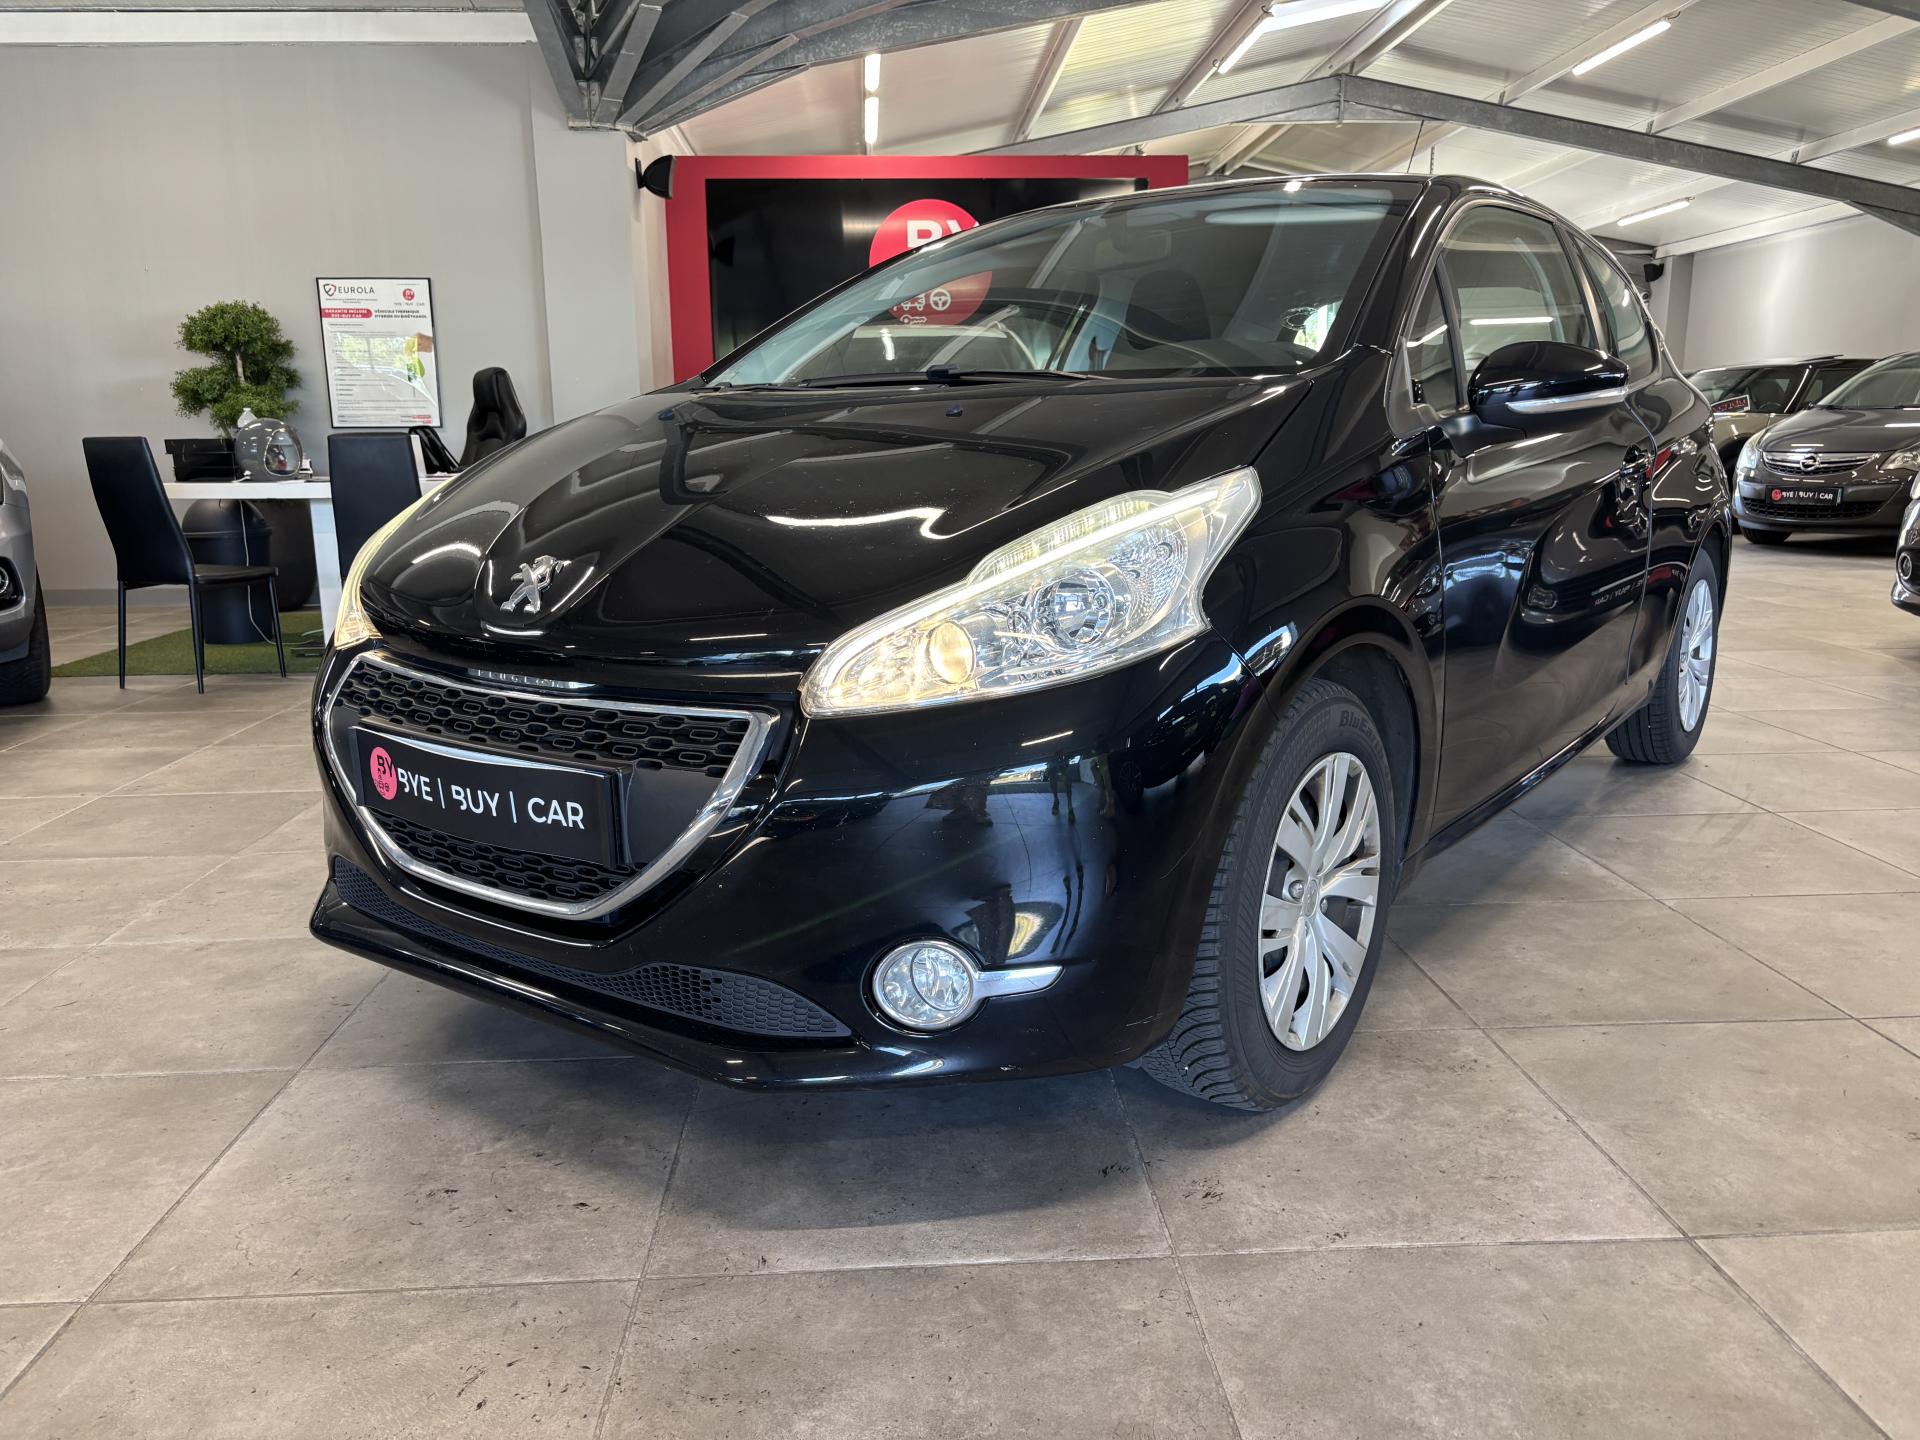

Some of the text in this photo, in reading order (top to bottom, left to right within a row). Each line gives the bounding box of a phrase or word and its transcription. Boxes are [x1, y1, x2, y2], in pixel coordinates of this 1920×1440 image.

[338, 286, 375, 294] EUROLA
[1819, 492, 1834, 500] CAR
[376, 754, 394, 778] BY
[397, 767, 433, 802] BYE
[451, 784, 500, 817] BUY
[527, 797, 585, 830] CAR
